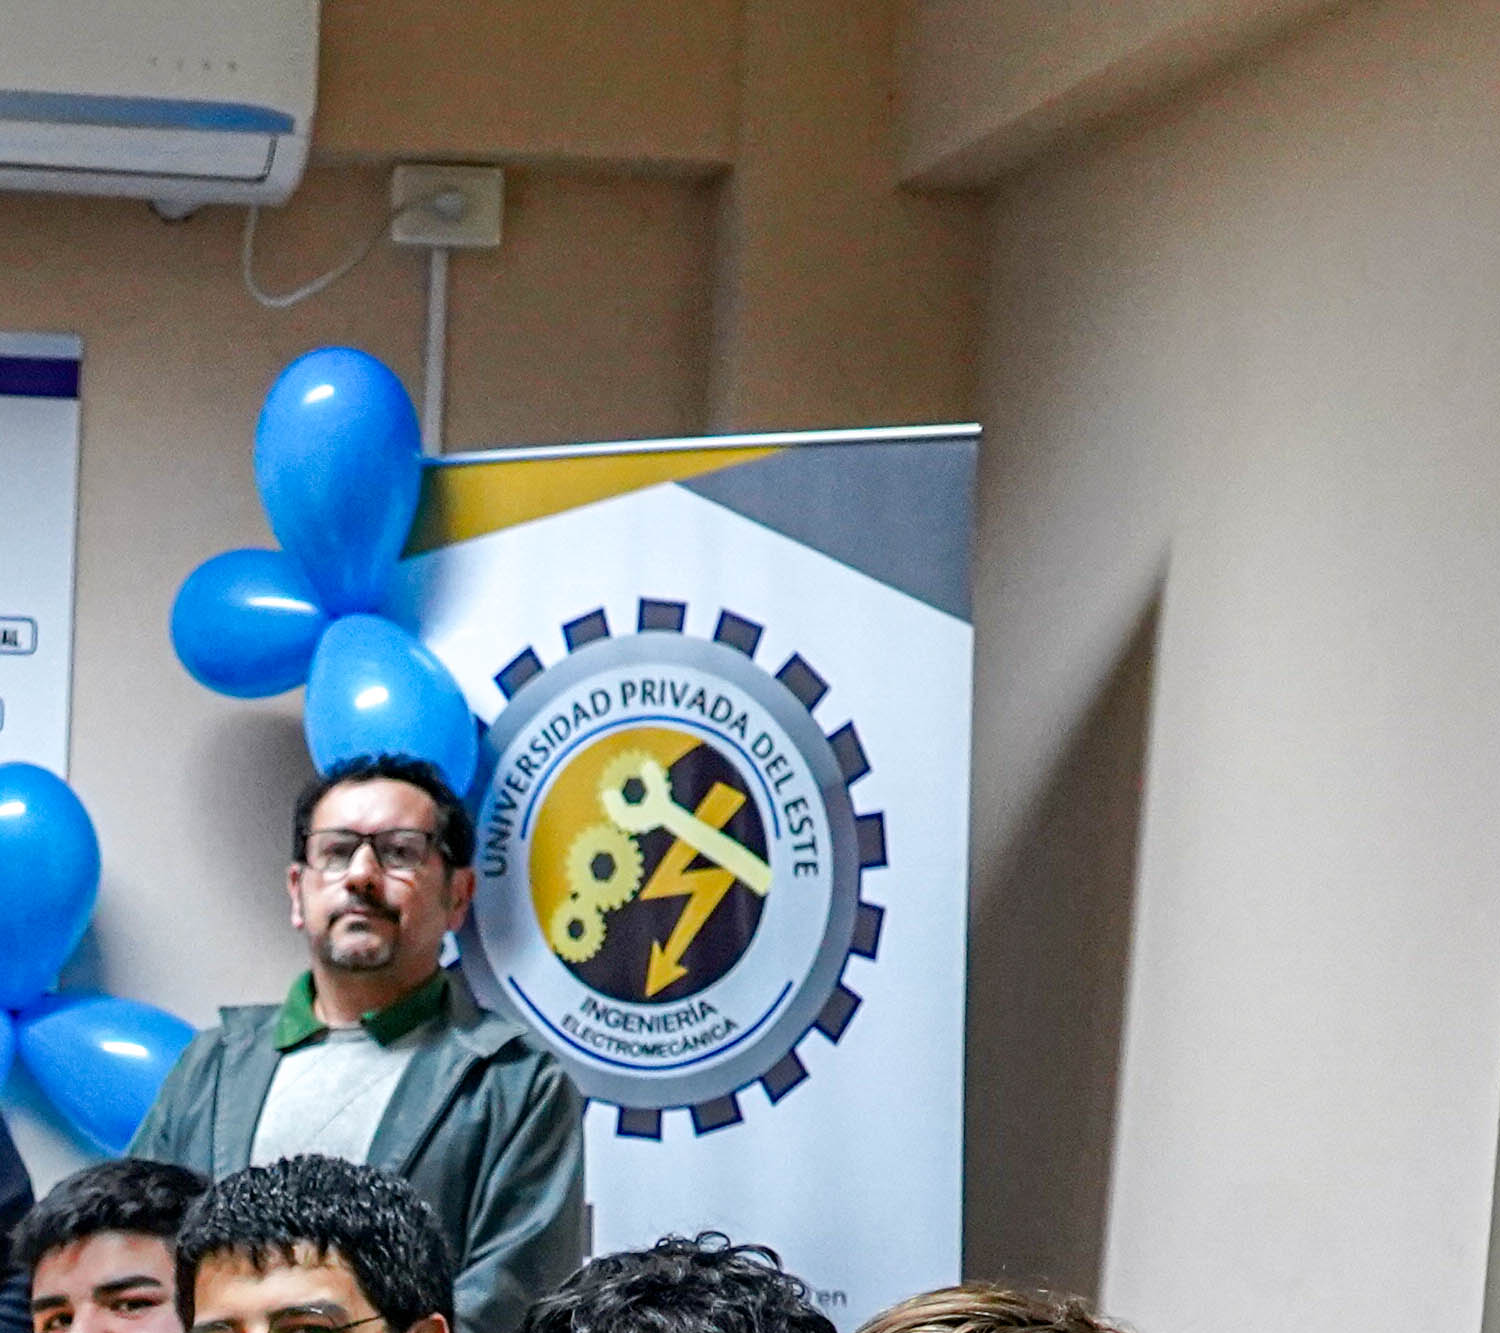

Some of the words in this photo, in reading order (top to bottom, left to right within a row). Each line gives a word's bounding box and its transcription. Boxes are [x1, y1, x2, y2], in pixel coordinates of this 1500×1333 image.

[484, 689, 611, 879] UNIVERSIDAD
[620, 680, 748, 739] PRIVADA
[751, 732, 791, 795] DEL
[783, 796, 820, 878] ESTE
[561, 1014, 739, 1059] ELECTROMECÁNICA
[579, 998, 719, 1034] INGENIERÍA
